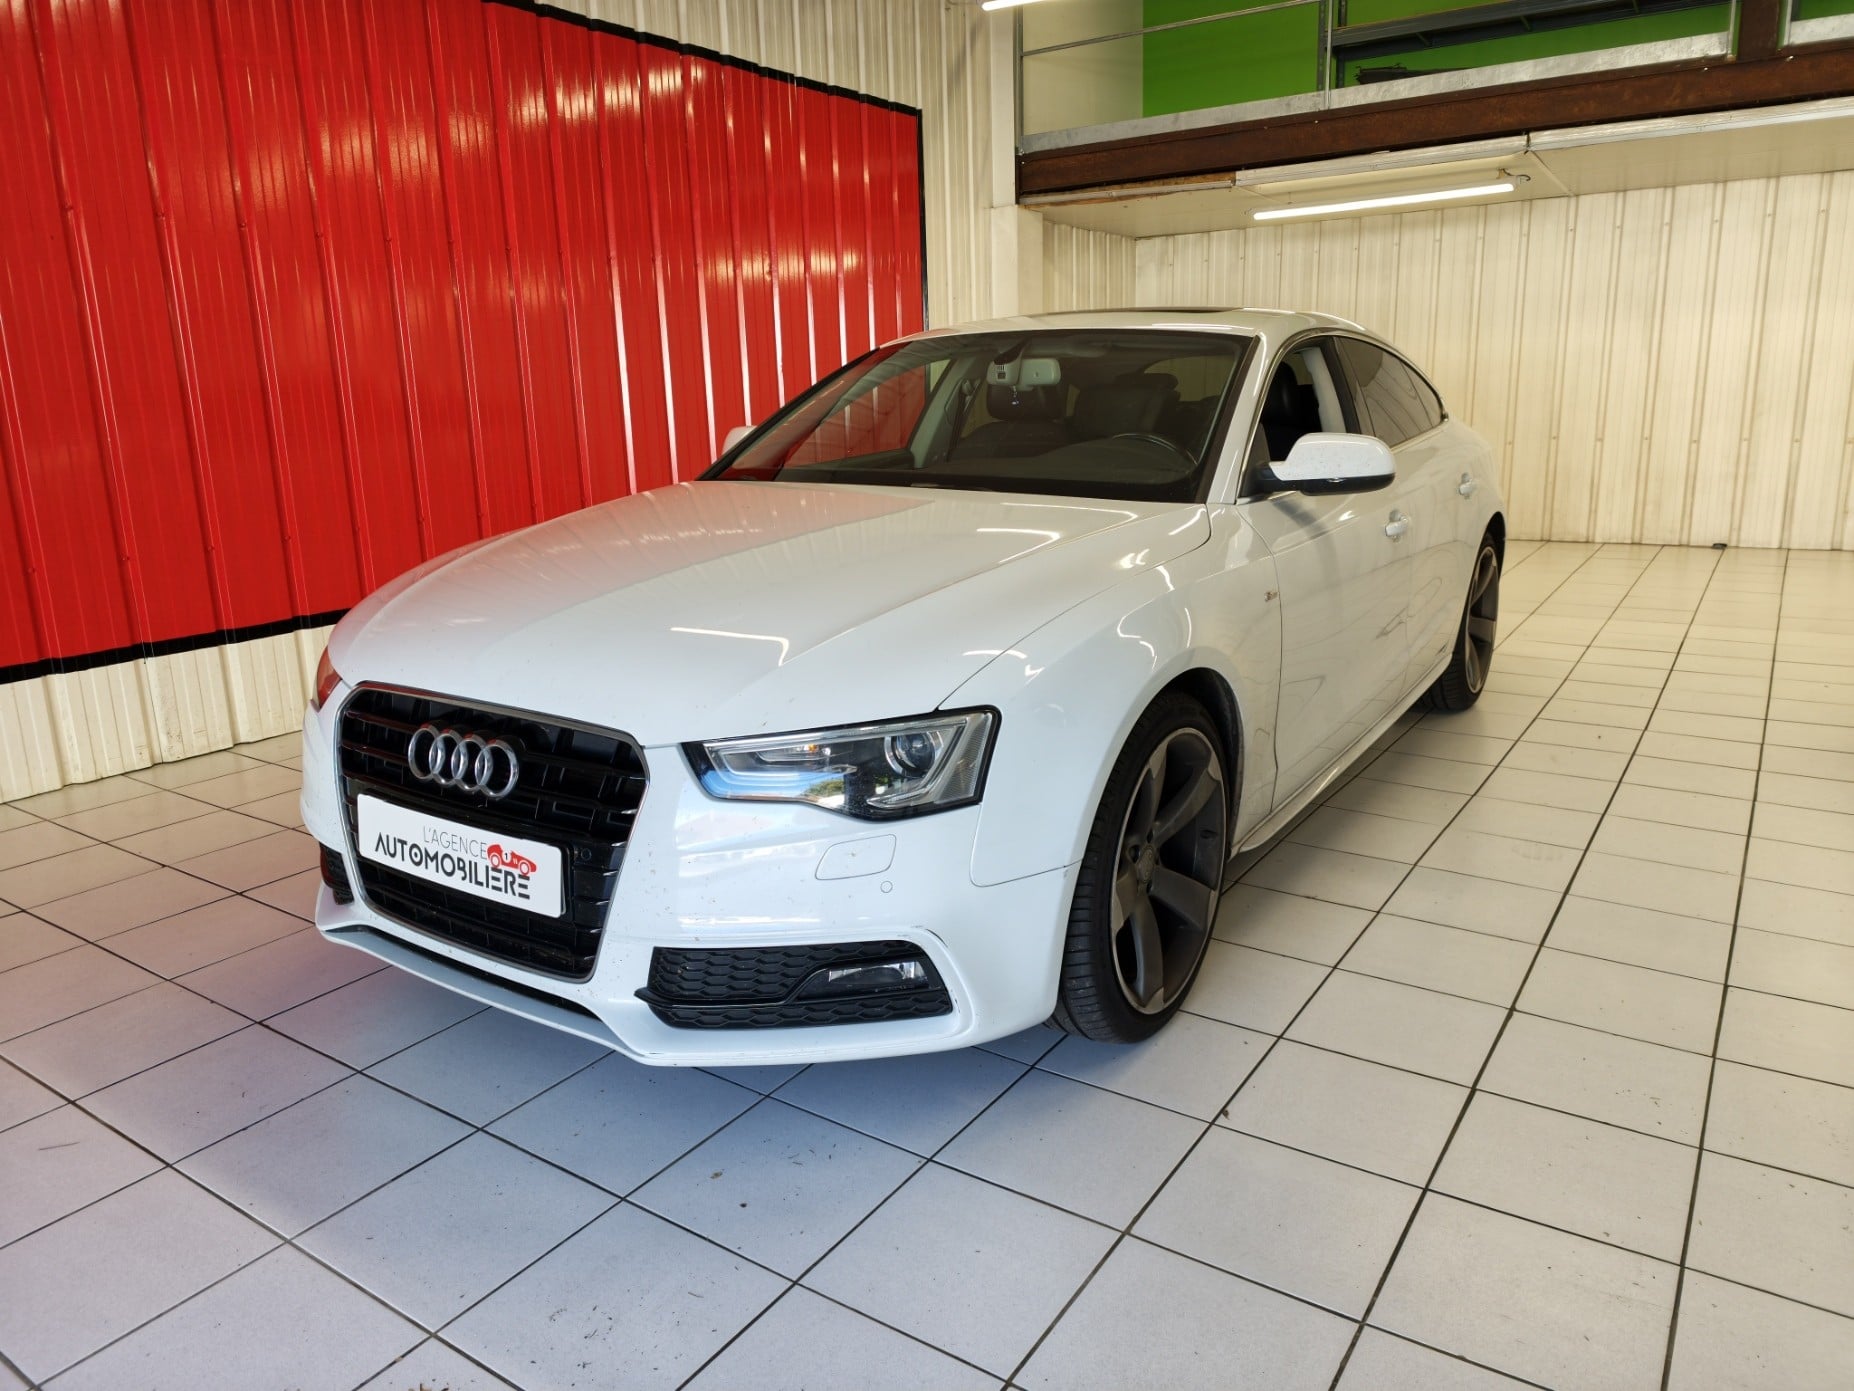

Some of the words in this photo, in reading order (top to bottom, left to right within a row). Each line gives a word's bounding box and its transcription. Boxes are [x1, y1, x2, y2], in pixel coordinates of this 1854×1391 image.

[423, 826, 488, 861] L'AGENCE
[504, 851, 510, 861] 1
[374, 832, 531, 900] AUTOMOBILIERE
